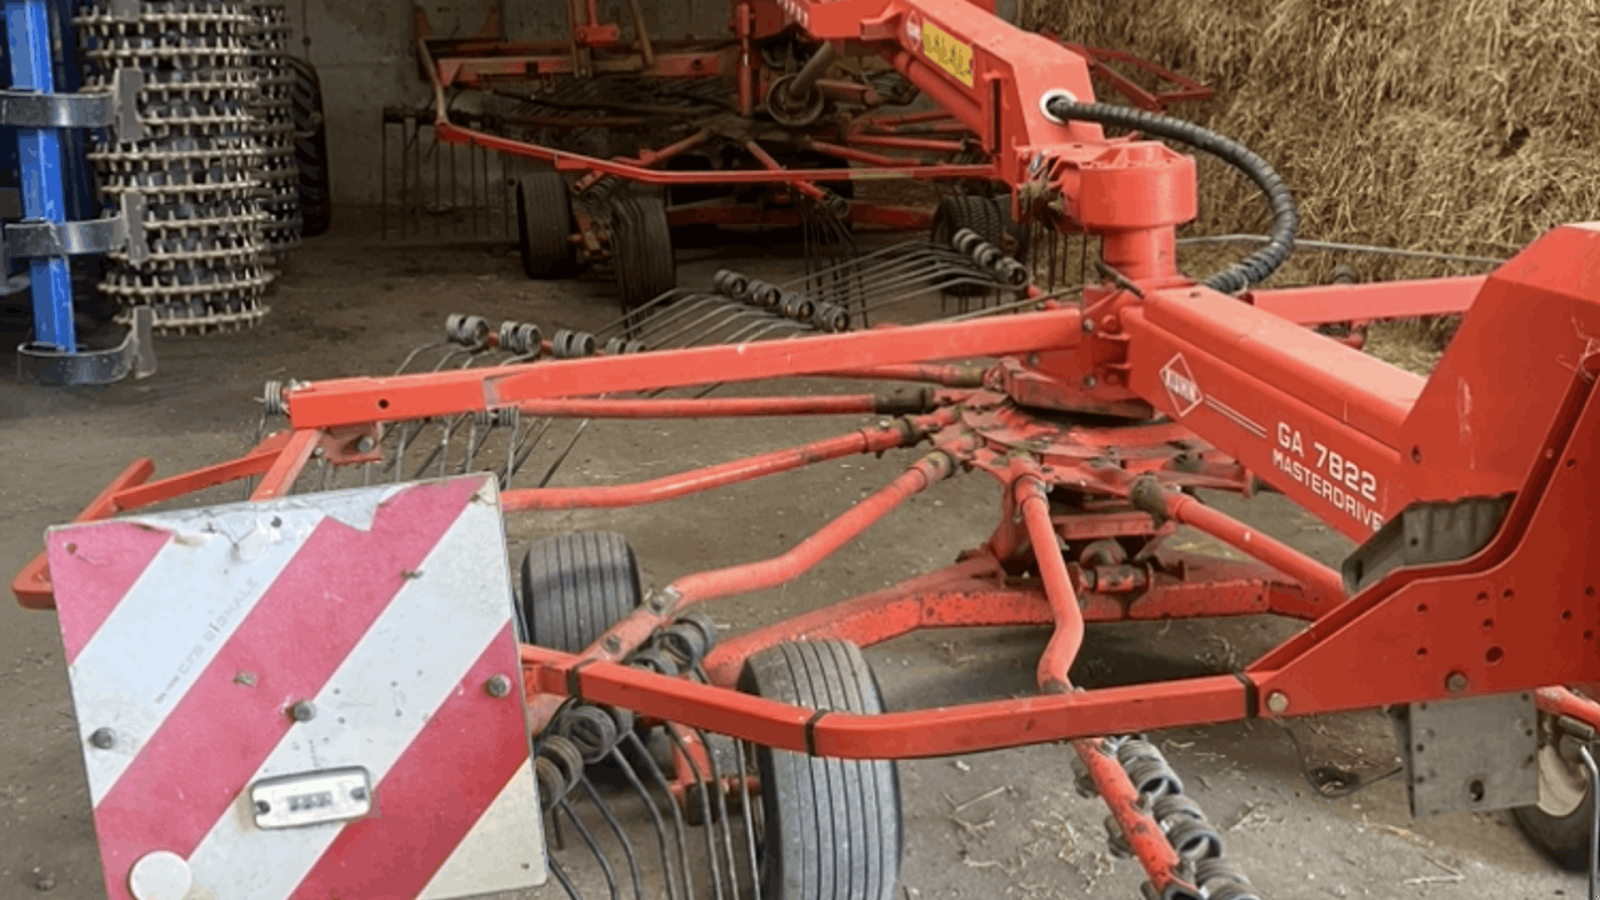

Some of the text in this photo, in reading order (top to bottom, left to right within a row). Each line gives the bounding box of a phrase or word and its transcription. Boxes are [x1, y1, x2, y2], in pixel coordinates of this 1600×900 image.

[1272, 448, 1384, 532] MASTERDRIVE
[1278, 421, 1377, 503] GA 7822
